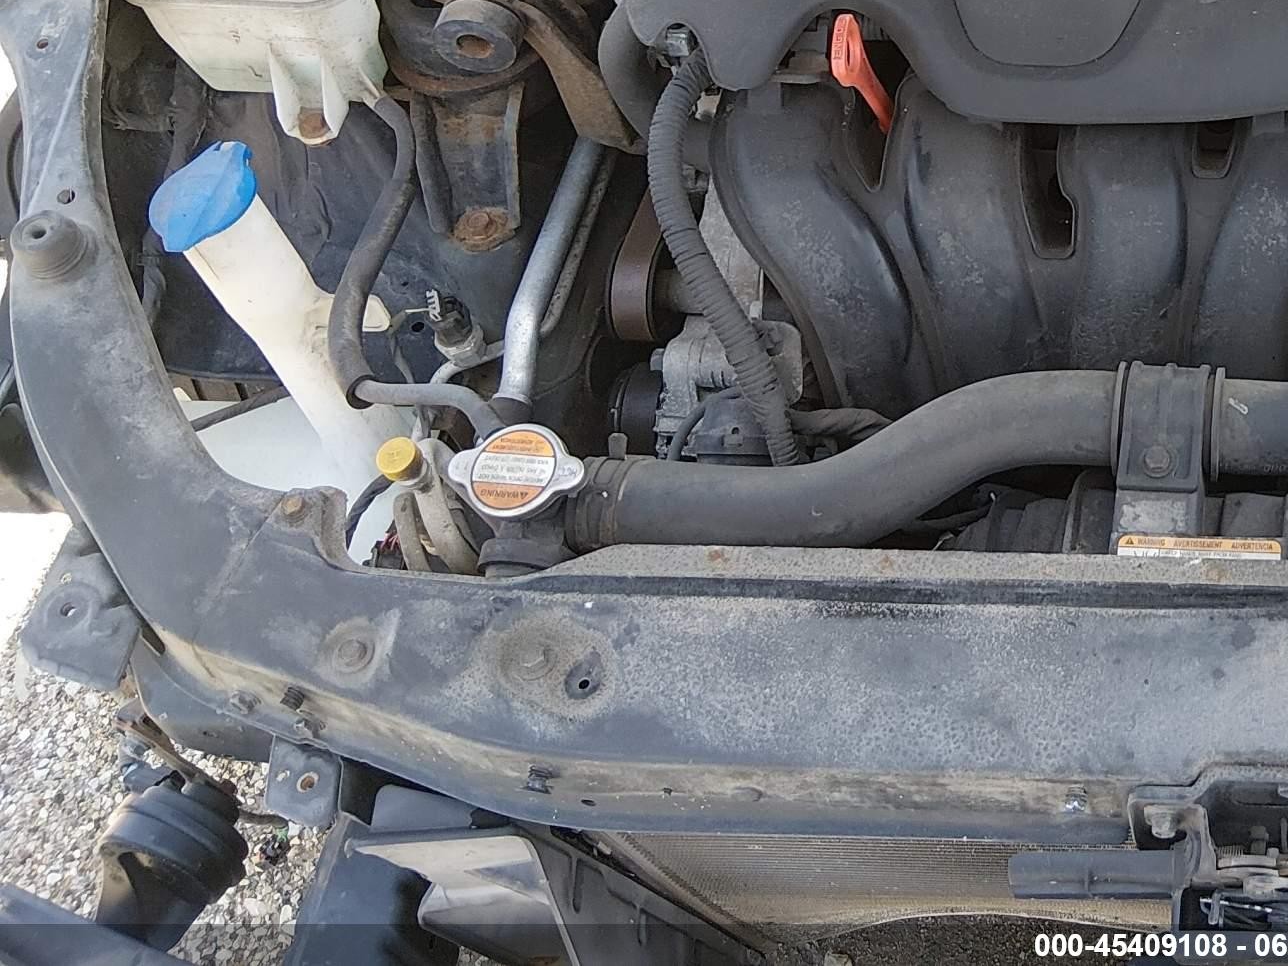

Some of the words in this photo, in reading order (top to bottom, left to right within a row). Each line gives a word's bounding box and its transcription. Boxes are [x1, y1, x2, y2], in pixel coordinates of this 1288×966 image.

[480, 488, 519, 499] WARNING
[1137, 538, 1166, 546] WARNING
[1173, 539, 1223, 548] AVERTISSEMENT
[1231, 541, 1273, 550] ADVERTENCIA
